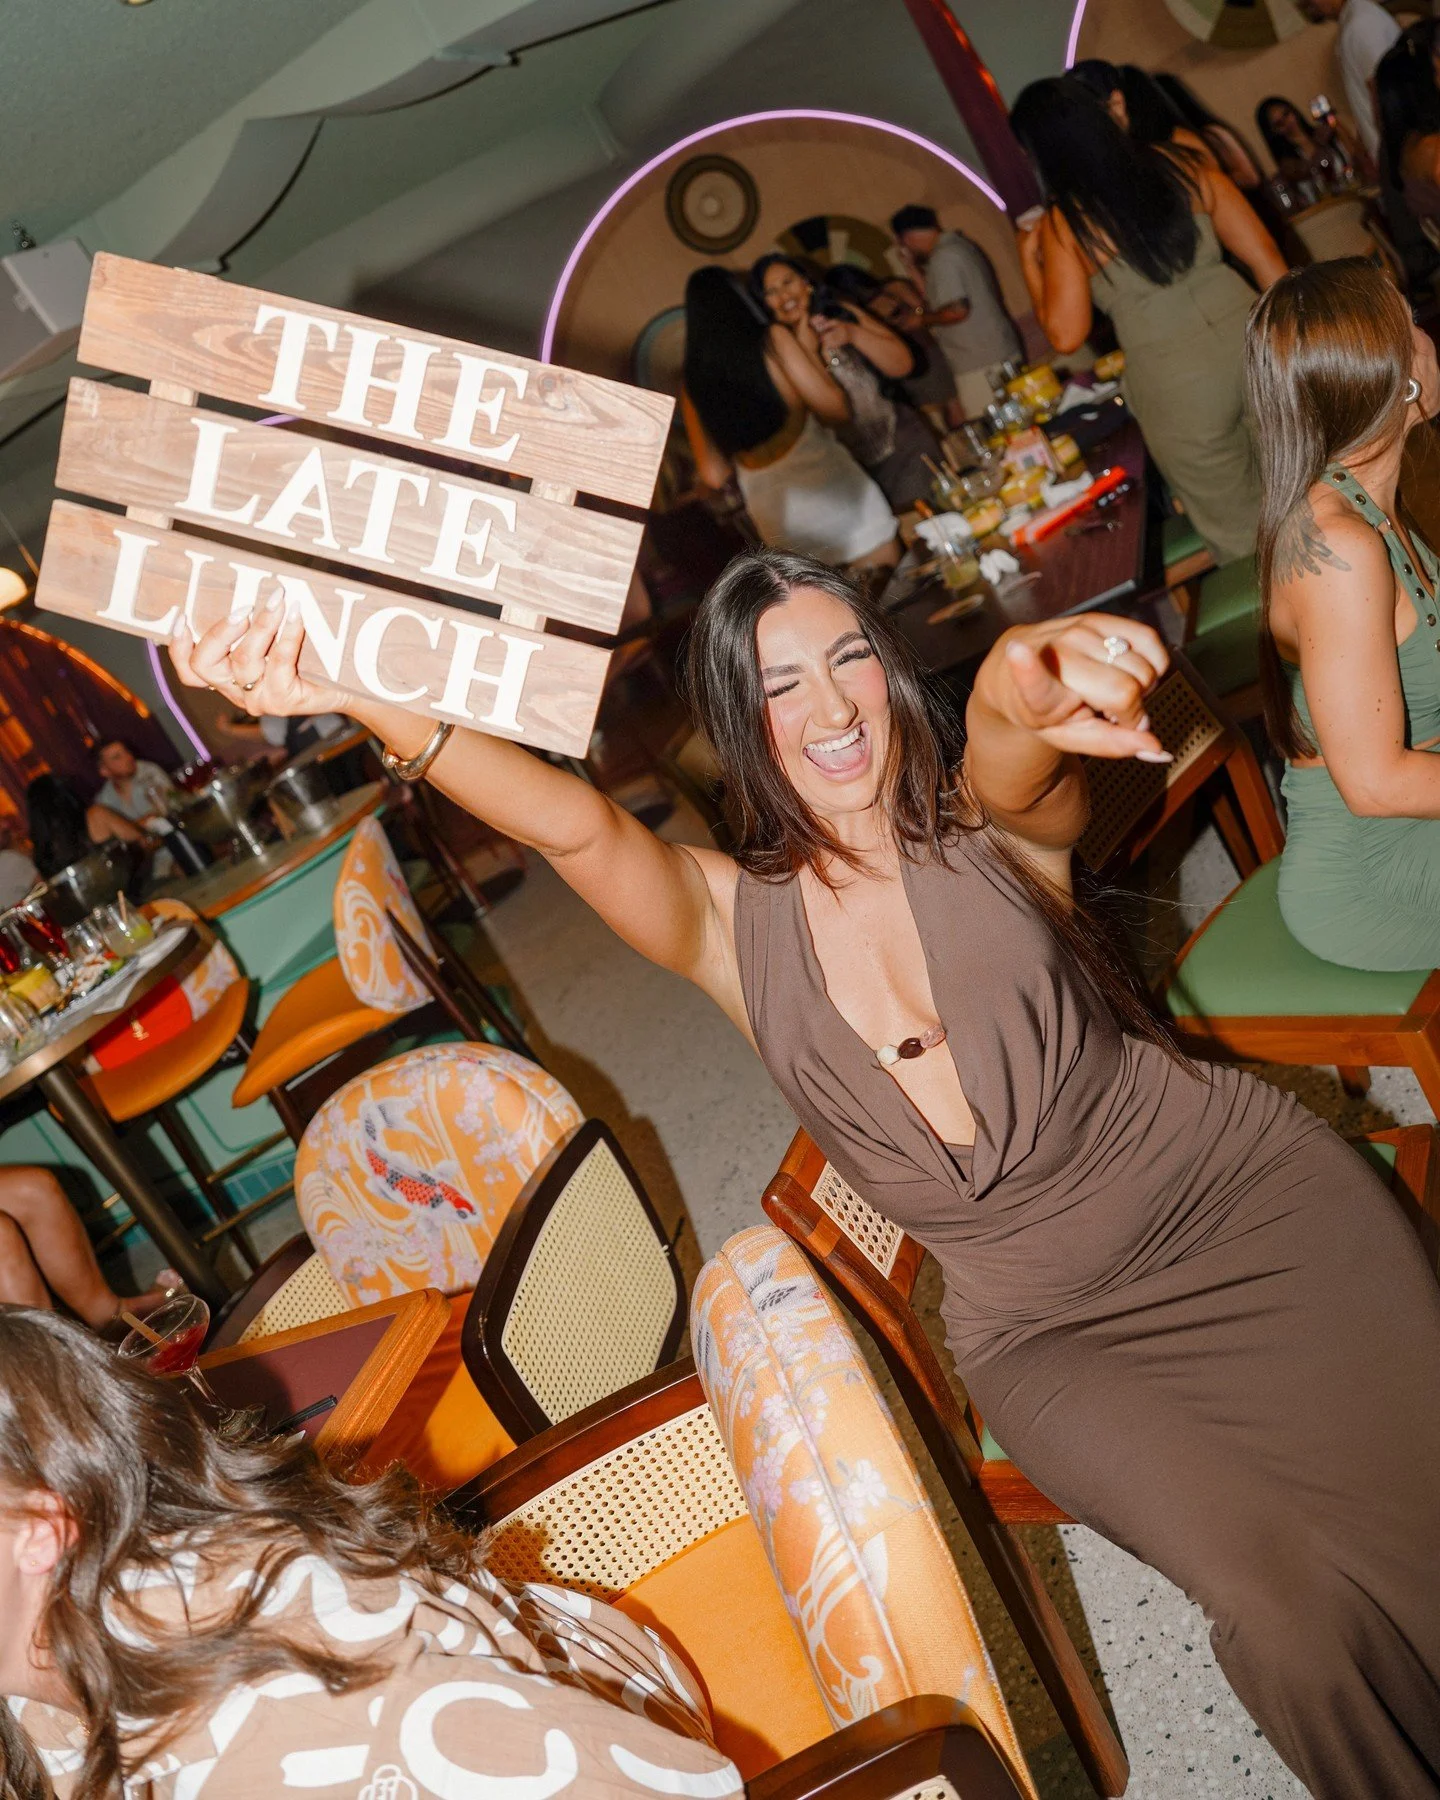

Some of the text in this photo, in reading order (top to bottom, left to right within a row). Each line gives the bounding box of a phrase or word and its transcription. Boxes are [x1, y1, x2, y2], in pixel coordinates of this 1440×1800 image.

[252, 304, 529, 462] THE
[174, 417, 517, 591] LATE
[97, 528, 544, 732] LUNCH
